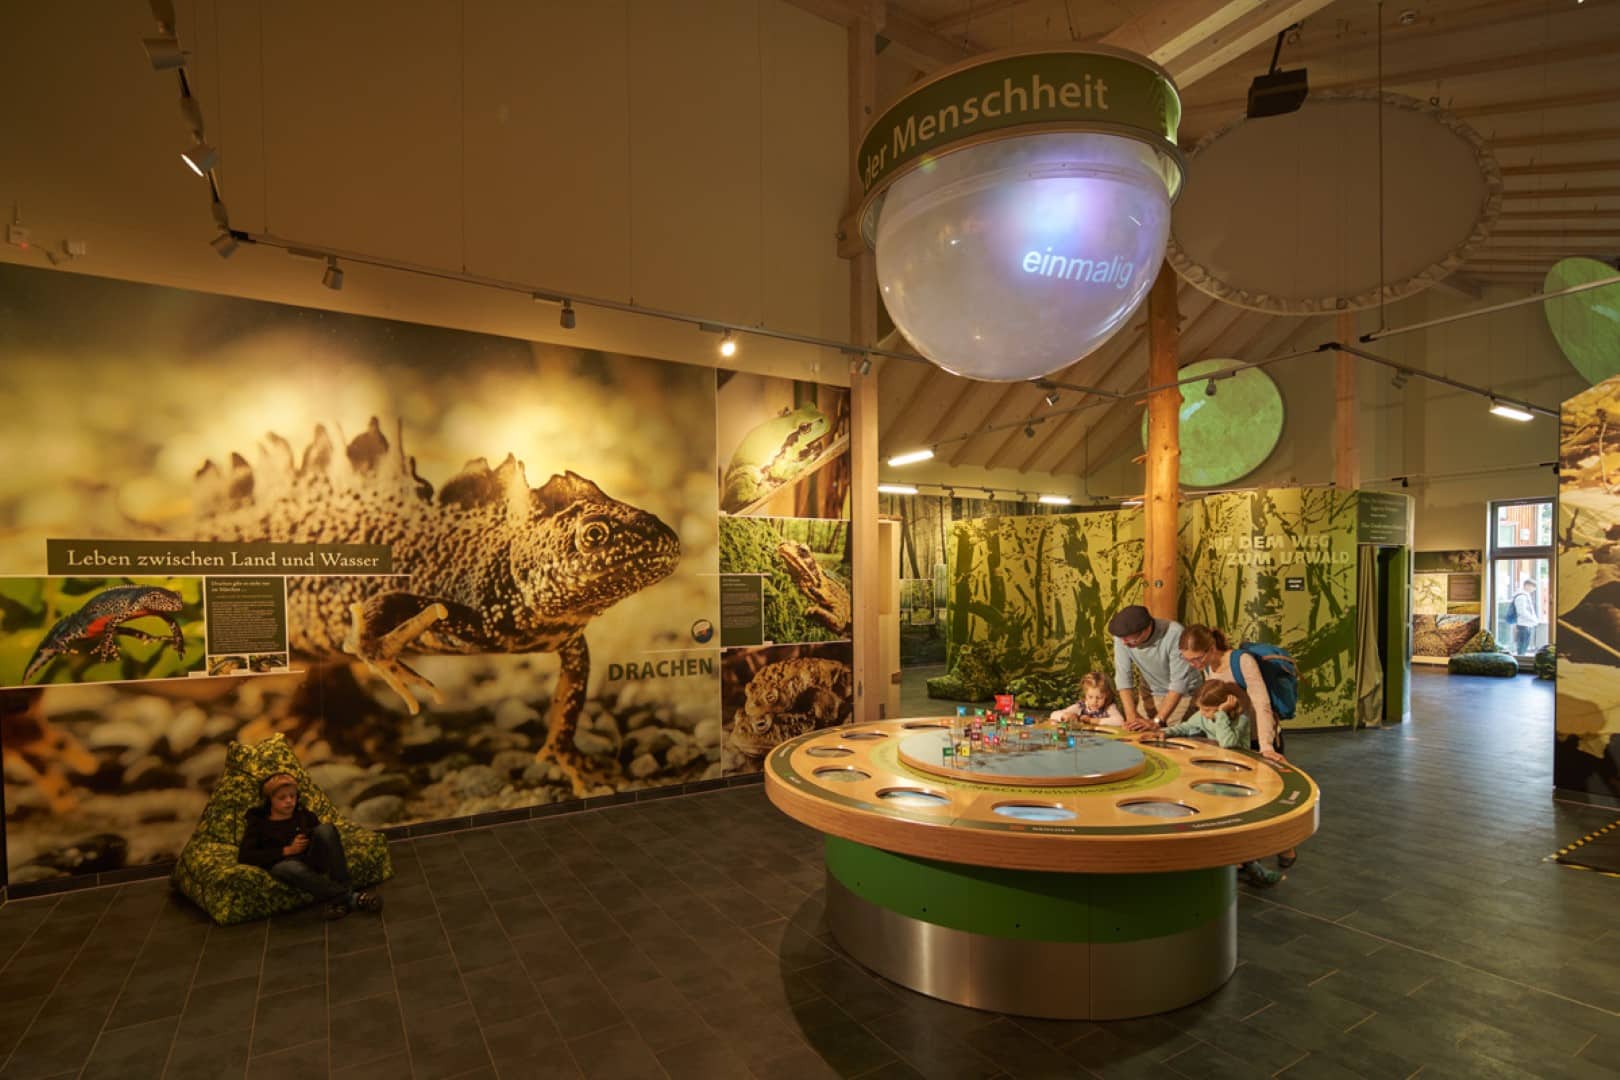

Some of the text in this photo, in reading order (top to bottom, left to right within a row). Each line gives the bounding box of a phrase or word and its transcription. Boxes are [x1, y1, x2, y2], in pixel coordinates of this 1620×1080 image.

[864, 74, 1109, 191] der Menschheit
[1022, 246, 1133, 290] einmalig
[1238, 535, 1285, 550] DEM
[1291, 535, 1330, 550] WEG
[67, 549, 380, 569] Leben zwischen Land und Wasser
[1226, 550, 1350, 565] ZUM URWALD
[608, 657, 714, 681] DRACHEN
